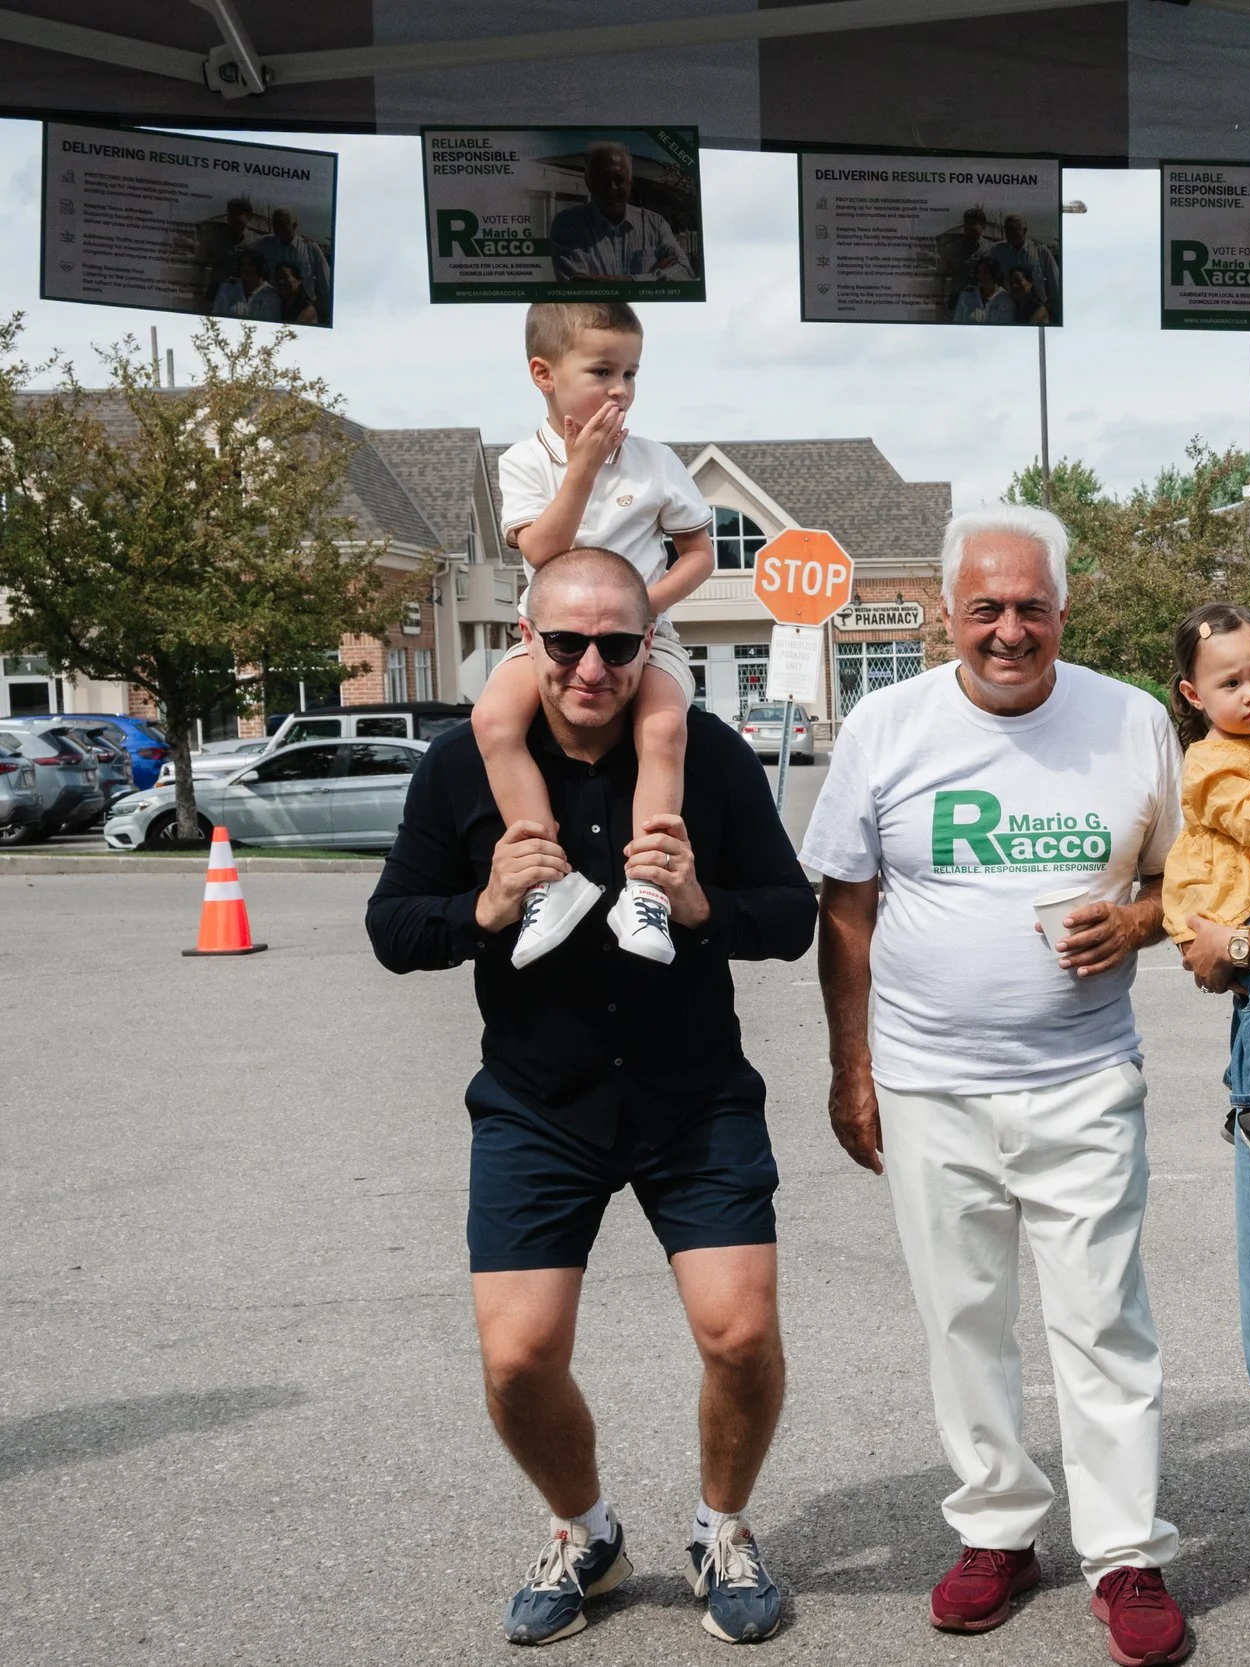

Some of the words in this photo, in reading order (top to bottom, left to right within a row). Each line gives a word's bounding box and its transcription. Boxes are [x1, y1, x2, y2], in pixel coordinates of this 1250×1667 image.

[432, 138, 492, 149] RELIABLE.
[657, 130, 695, 167] RE-ELECT
[62, 140, 145, 161] DELIVERING
[149, 151, 209, 168] RESULTS
[213, 159, 239, 173] FOR
[244, 162, 310, 180] VAUGHAN
[432, 151, 520, 162] RESPONSIBLE.
[433, 164, 514, 175] RESPONSIVE.
[815, 169, 889, 181] DELIVERING
[892, 171, 946, 183] RESULTS
[949, 173, 973, 184] FOR
[977, 174, 1038, 186] VAUGHAN
[1170, 172, 1226, 183] RELIABLE.
[1170, 184, 1250, 196] RESPONSIBLE.
[1170, 198, 1244, 209] RESPONSIVE.
[482, 215, 508, 224] VOTE
[511, 215, 531, 224] FOR
[482, 228, 518, 238] Mario
[1213, 247, 1236, 255] VOTE
[1212, 259, 1244, 269] Mario
[761, 557, 847, 597] STOP
[856, 612, 919, 625] PHARMACY
[1009, 812, 1077, 832] Mario
[1085, 813, 1107, 830] G.
[933, 866, 982, 874] RELIABLE.
[984, 865, 1051, 873] RESPONSIBLE.
[1053, 864, 1107, 872] RESPONSIVE.
